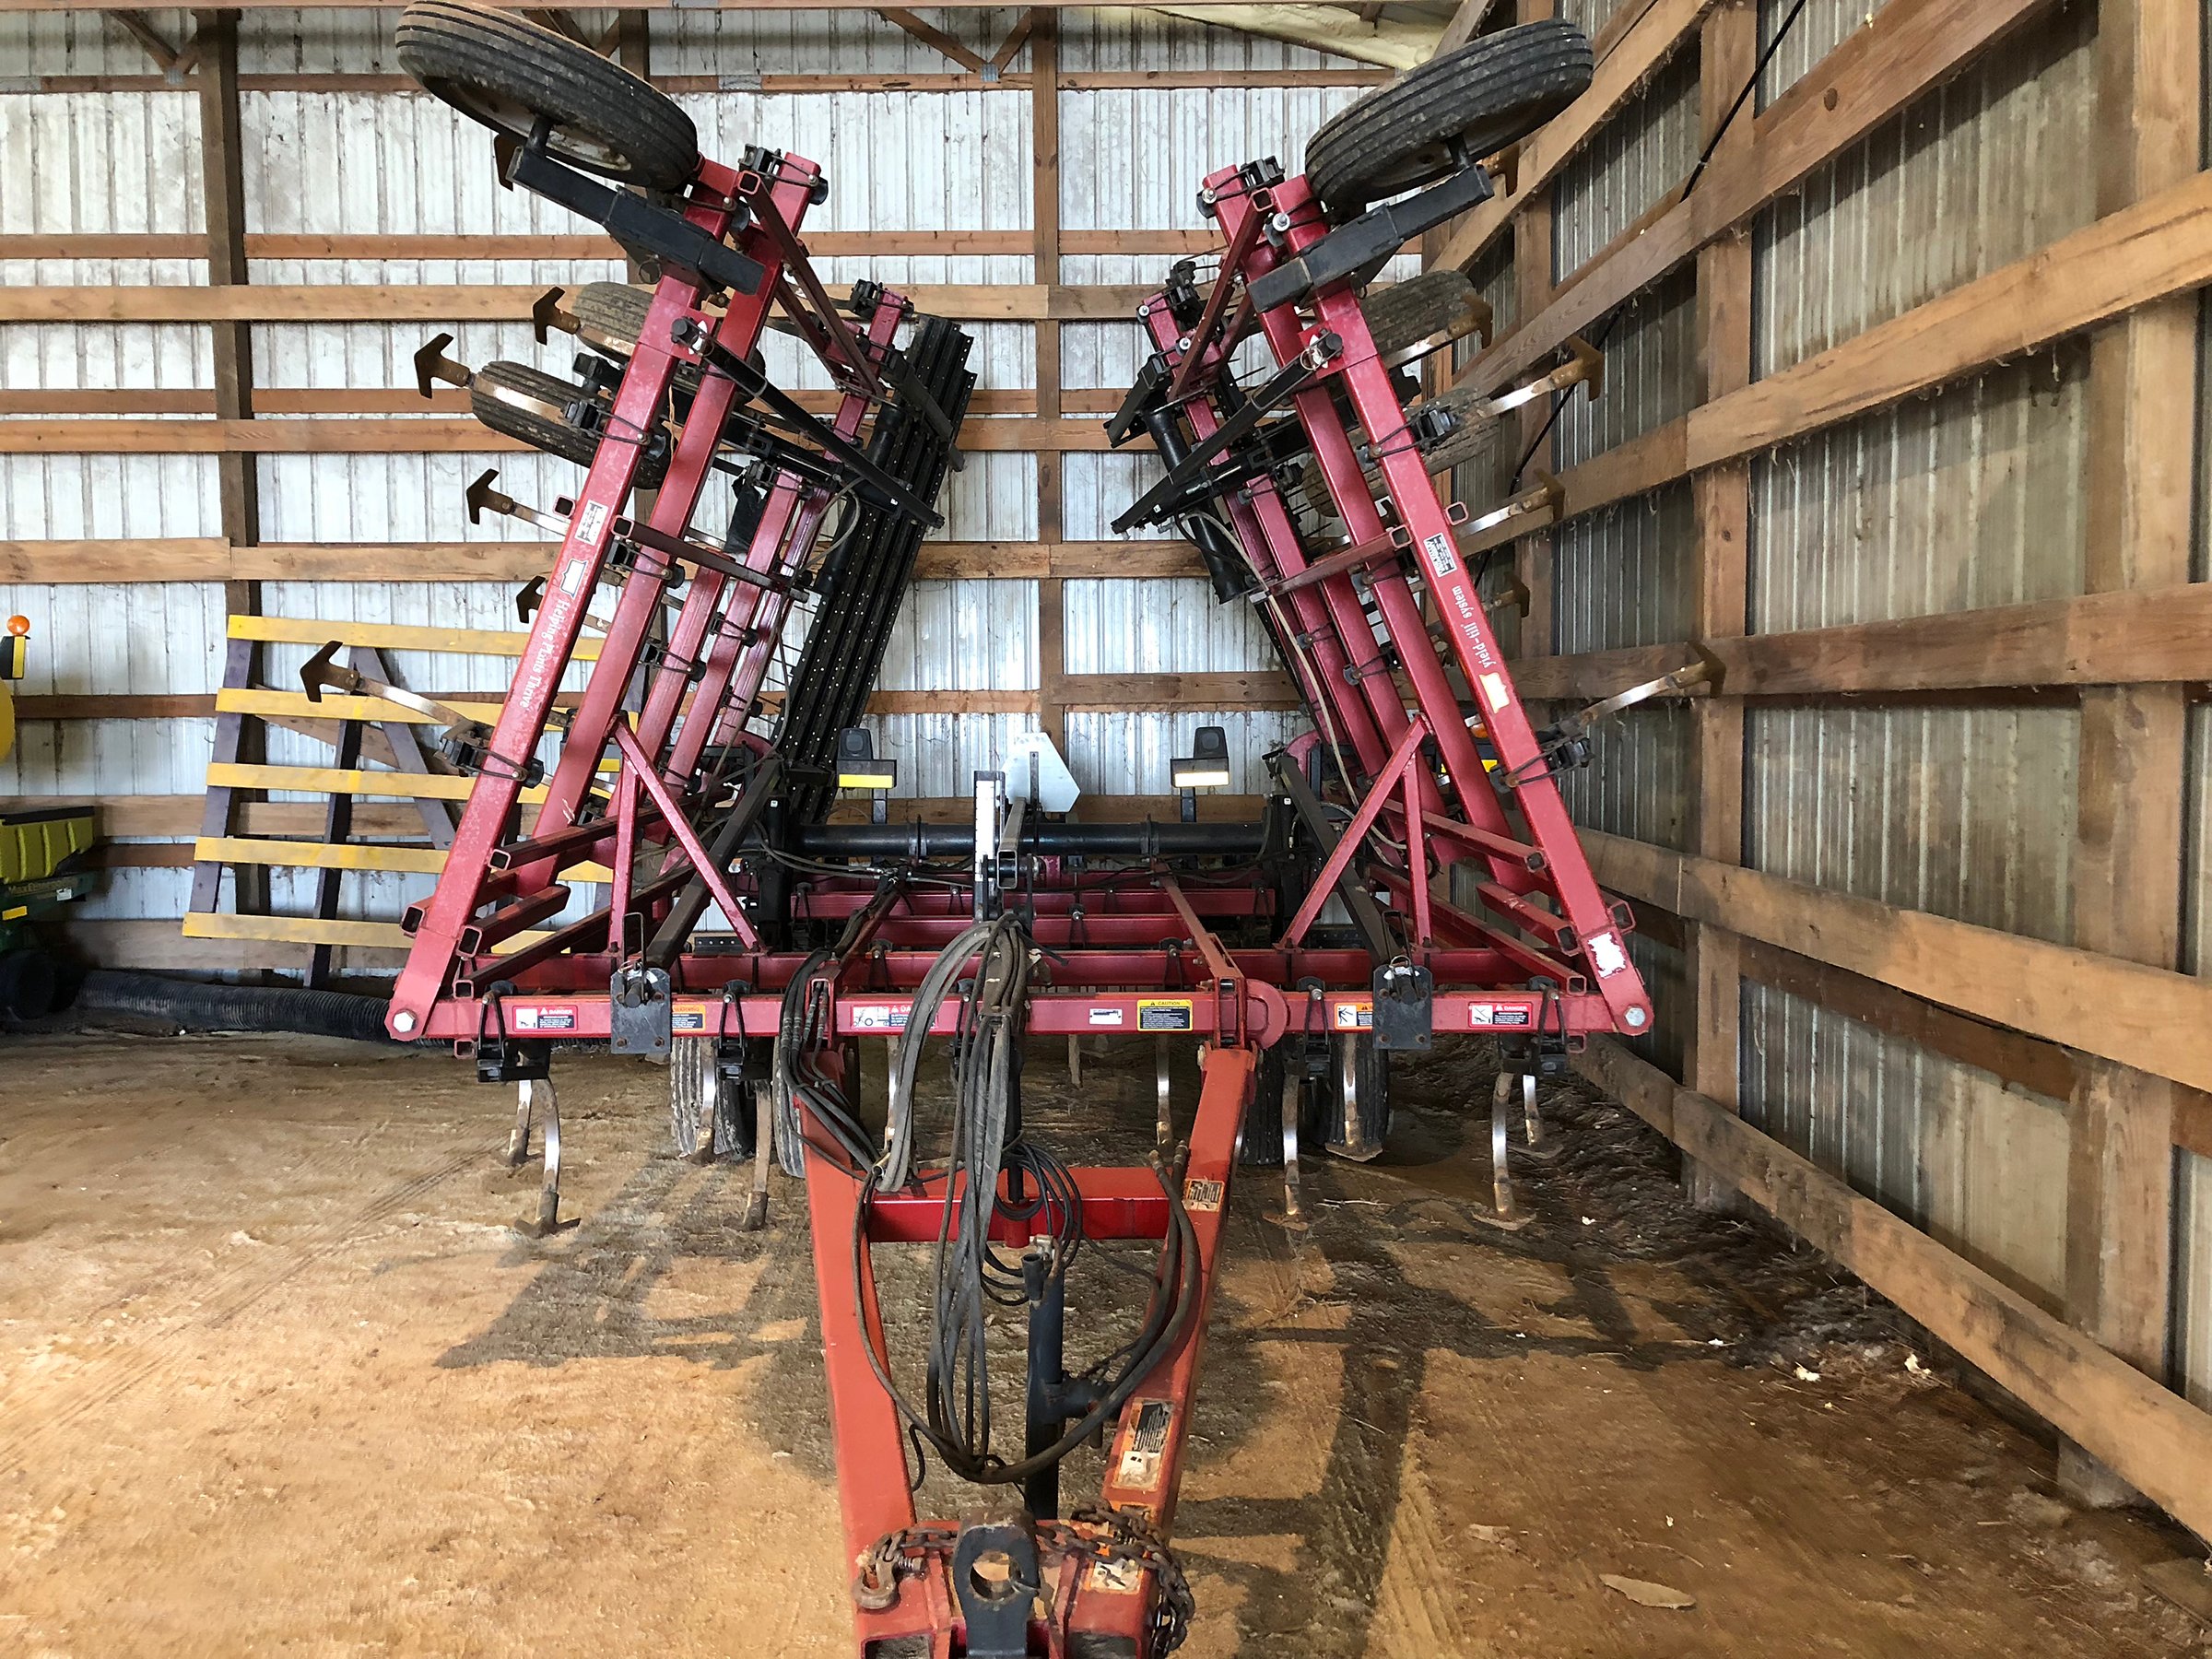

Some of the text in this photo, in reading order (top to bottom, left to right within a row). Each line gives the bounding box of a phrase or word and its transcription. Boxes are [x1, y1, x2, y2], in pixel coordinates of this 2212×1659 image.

[1452, 585, 1474, 618] system
[520, 599, 571, 708] Helping Plants Thrive
